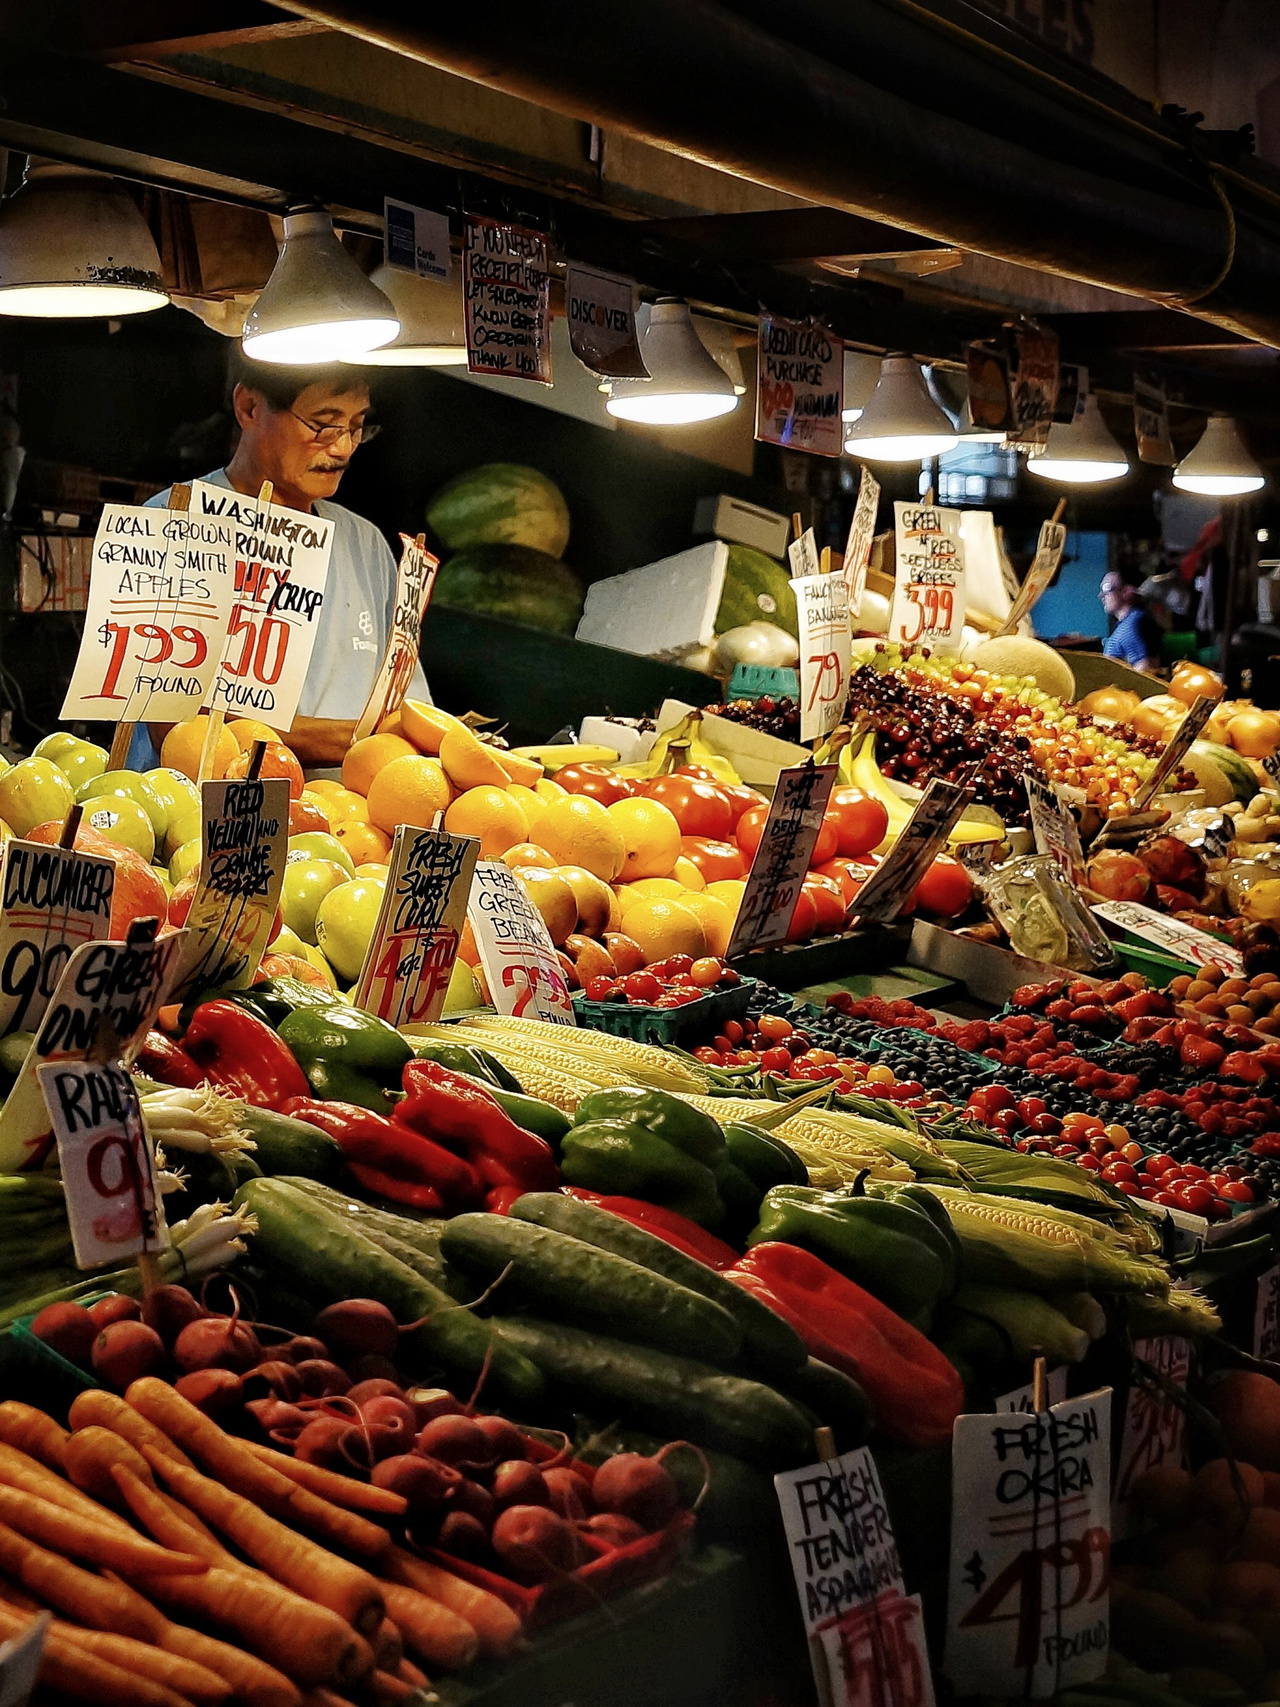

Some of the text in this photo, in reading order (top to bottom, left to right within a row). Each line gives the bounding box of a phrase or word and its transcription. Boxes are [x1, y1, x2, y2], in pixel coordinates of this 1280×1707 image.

[473, 303, 509, 325] KNOW
[570, 297, 629, 334] DISCOVER
[470, 349, 512, 370] THANK
[766, 355, 823, 386] PURCHASE
[106, 513, 233, 547] LOCAL GROWN
[201, 490, 328, 550] WASHINGTON
[902, 509, 942, 533] GREEN
[97, 541, 228, 575] GRANNY SMITH
[235, 532, 295, 567] ROWN
[930, 539, 957, 557] RED
[118, 568, 211, 600] APPLES
[134, 675, 203, 696] POUND
[215, 676, 276, 711] POUND
[223, 781, 265, 819] RED
[407, 832, 470, 874] FRESH
[2, 849, 115, 919] CUCUMBER
[396, 870, 460, 900] SWEET
[394, 898, 449, 933] CORN
[993, 1407, 1099, 1461] FRESH
[794, 1451, 879, 1535] FRESH
[996, 1455, 1094, 1504] OKRA
[794, 1503, 896, 1578] TENDER
[1044, 1620, 1108, 1666] POUND
